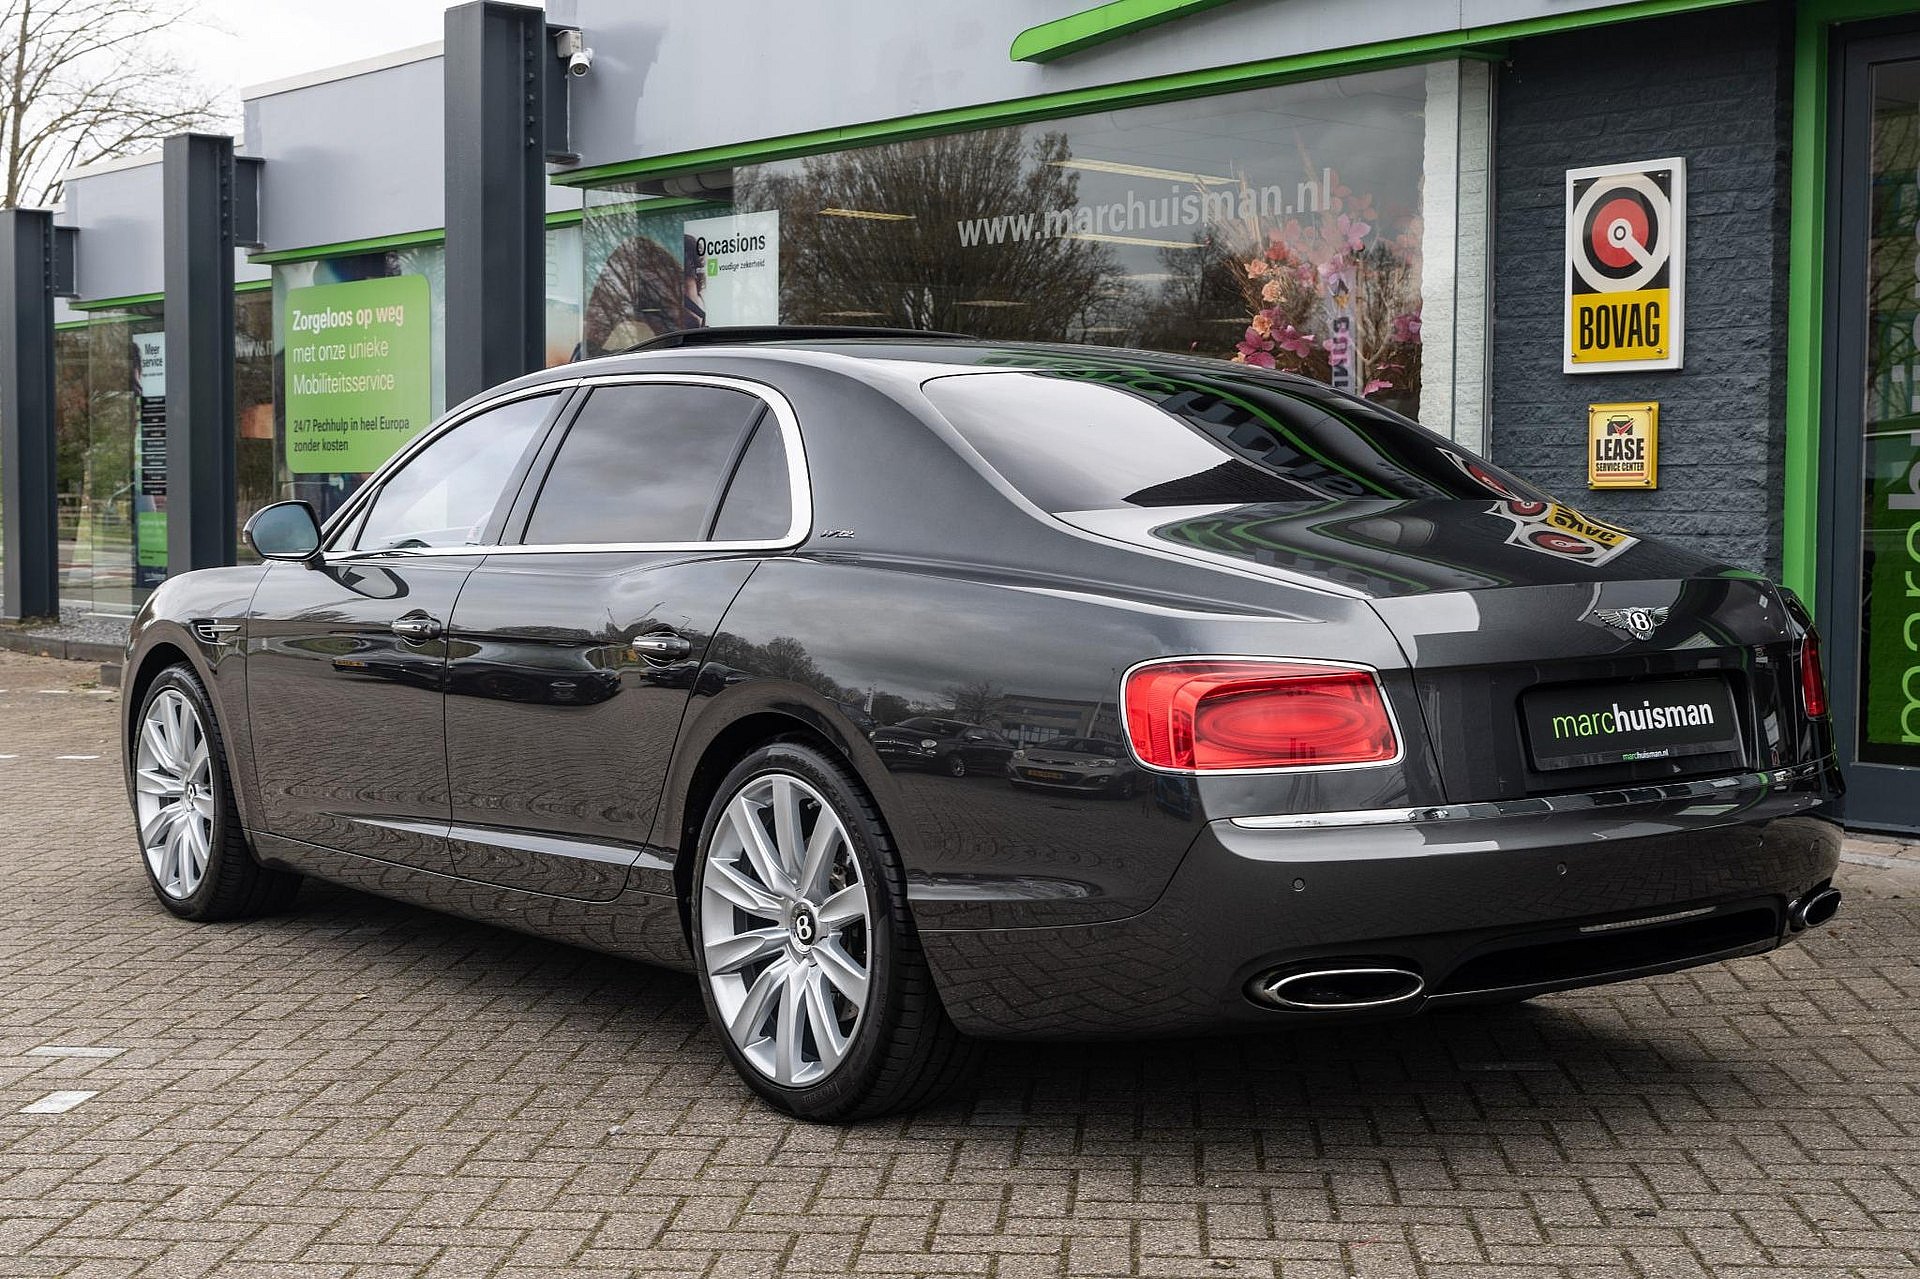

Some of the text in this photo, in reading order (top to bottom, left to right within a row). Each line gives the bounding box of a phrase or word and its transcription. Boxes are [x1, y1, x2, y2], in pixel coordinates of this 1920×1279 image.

[957, 167, 1332, 248] www.marchuisman.nl
[696, 232, 766, 257] Occasions
[708, 262, 715, 272] 7
[292, 304, 404, 335] Zorgeloos op weg
[1579, 301, 1660, 350] BOVAG
[144, 343, 160, 355] Meer
[293, 343, 316, 363] met
[318, 343, 346, 362] onze
[349, 336, 389, 360] unieke
[142, 357, 163, 368] service
[293, 369, 395, 395] Mobiliteitsservice
[293, 416, 410, 435] 24/7 Pechhulp in heel Europa
[293, 438, 349, 452] zonder kosten
[1595, 437, 1645, 461] LEASE
[1595, 461, 1645, 472] SERVICE CENTER
[1552, 700, 1714, 739] marchuisman
[1622, 748, 1669, 761] marchuisman.nl
